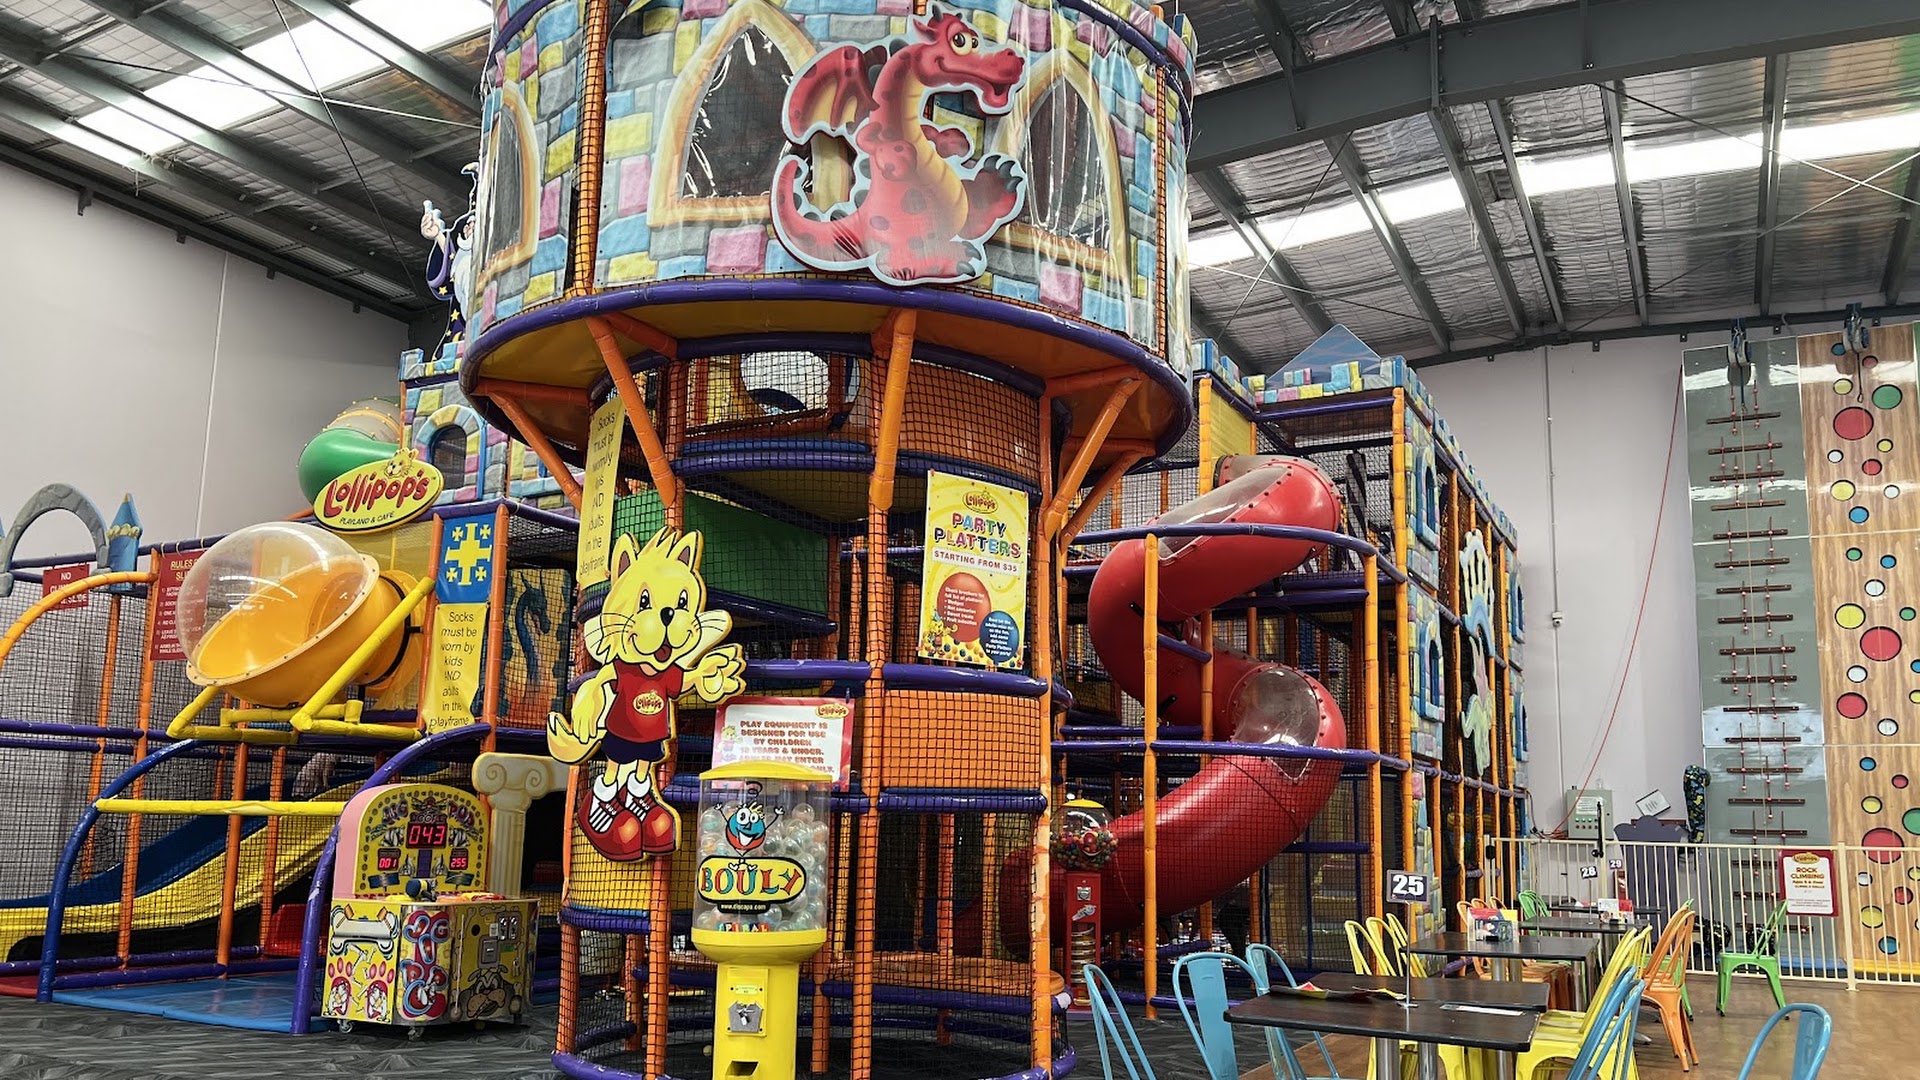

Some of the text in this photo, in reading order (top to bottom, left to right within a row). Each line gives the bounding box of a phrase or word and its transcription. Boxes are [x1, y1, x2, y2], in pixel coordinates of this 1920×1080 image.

[324, 468, 430, 518] Lollipop's
[952, 512, 1006, 538] PARTY
[934, 527, 1021, 558] PLATTERS
[170, 558, 193, 569] RULES
[934, 550, 1017, 572] STARTING FROM $35
[61, 572, 71, 581] NO
[449, 611, 474, 622] Socks
[441, 627, 477, 637] must be
[463, 642, 474, 654] by
[444, 656, 463, 666] kids
[442, 701, 462, 711] in the
[740, 720, 762, 728] PLAY
[764, 721, 816, 729] EQUIPMENT
[741, 729, 826, 738] DESIGNED FOR USE
[767, 738, 812, 746] CHILDREN
[795, 756, 824, 764] ENTER
[408, 825, 446, 845] 043
[378, 857, 397, 868] 001
[451, 857, 466, 868] 255
[1610, 860, 1621, 868] 29
[1582, 866, 1596, 877] 28
[701, 867, 802, 896] BOULY
[1393, 874, 1424, 896] 25
